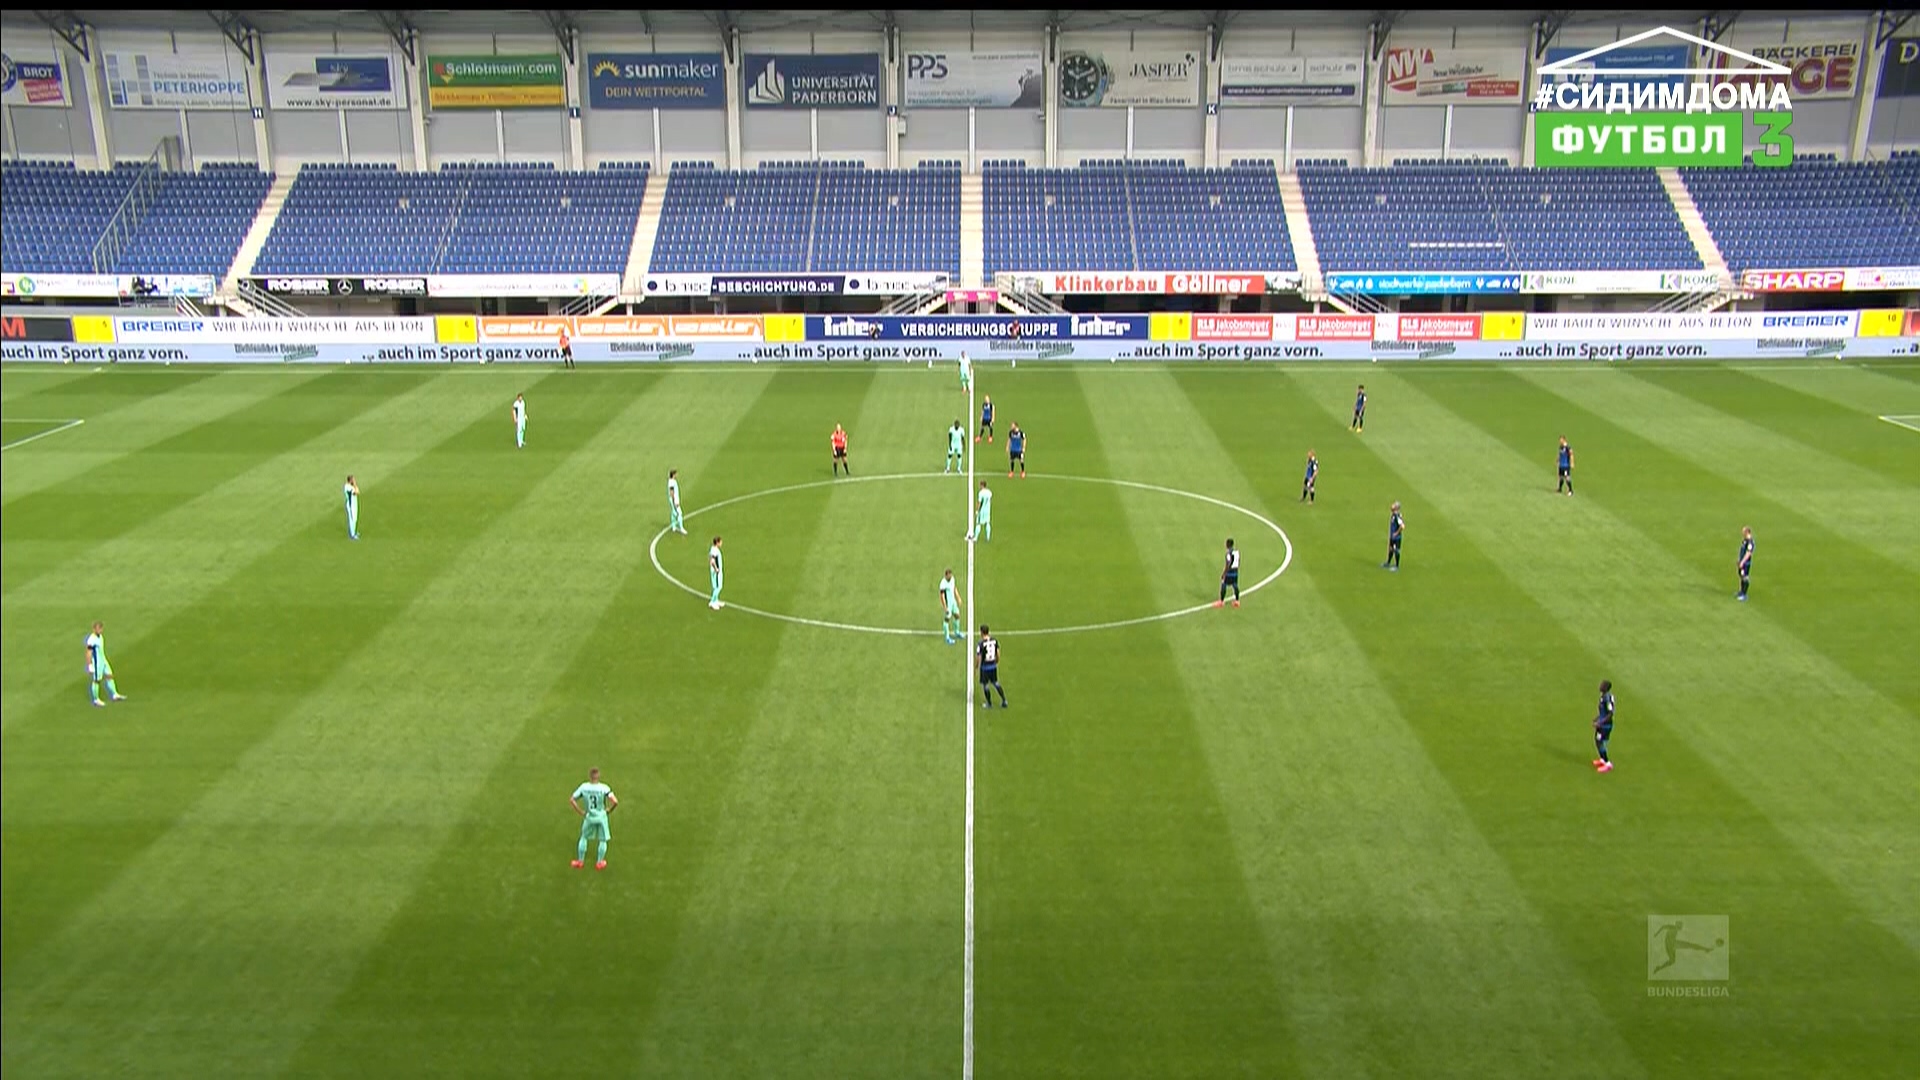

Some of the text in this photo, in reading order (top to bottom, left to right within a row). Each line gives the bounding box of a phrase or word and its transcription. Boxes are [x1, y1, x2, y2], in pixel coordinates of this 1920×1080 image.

[1752, 44, 1857, 60] BÄCKEREI
[23, 66, 54, 78] BROT
[446, 62, 557, 76] Schlotmann.com
[624, 59, 719, 79] sunmaker
[1129, 63, 1188, 78] JASPER
[153, 81, 246, 94] PETERHOPPE
[791, 74, 876, 89] UNIVERSITÄT
[605, 86, 707, 97] DEIN WETTPORTAL
[792, 90, 877, 104] PADERBORN
[287, 97, 392, 107] www.sky-personal.de
[1208, 104, 1216, 114] K
[254, 108, 262, 118] H
[1055, 274, 1252, 293] Klinkerbau Göllner
[1744, 272, 1844, 290] SHARP
[122, 320, 204, 332] BREMER
[212, 321, 237, 333] WIR
[355, 321, 379, 333] AUS
[1070, 314, 1131, 336] inter
[1679, 317, 1704, 329] AUS
[1763, 315, 1848, 328] BREMER
[38, 345, 58, 358] im
[61, 345, 104, 363] Sport
[108, 349, 146, 363] ganz
[149, 349, 189, 358] vorn.
[378, 345, 414, 358] auch
[418, 345, 437, 358] im
[440, 345, 483, 363] Sport
[486, 349, 522, 363] ganz
[526, 349, 565, 358] vorn.
[755, 343, 791, 356] auch
[794, 343, 813, 356] im
[817, 343, 859, 361] Sport
[863, 347, 900, 361] ganz
[903, 347, 943, 356] vorn.
[1134, 343, 1171, 356] auch
[1175, 343, 1194, 356] im
[1197, 343, 1241, 361] Sport
[1244, 347, 1280, 361] ganz
[1284, 347, 1324, 356] vorn.
[1515, 342, 1553, 355] auch
[1556, 342, 1575, 355] im
[1579, 342, 1623, 360] Sport
[1626, 346, 1664, 360] ganz
[1667, 346, 1708, 355] vorn.
[589, 795, 597, 810] 3
